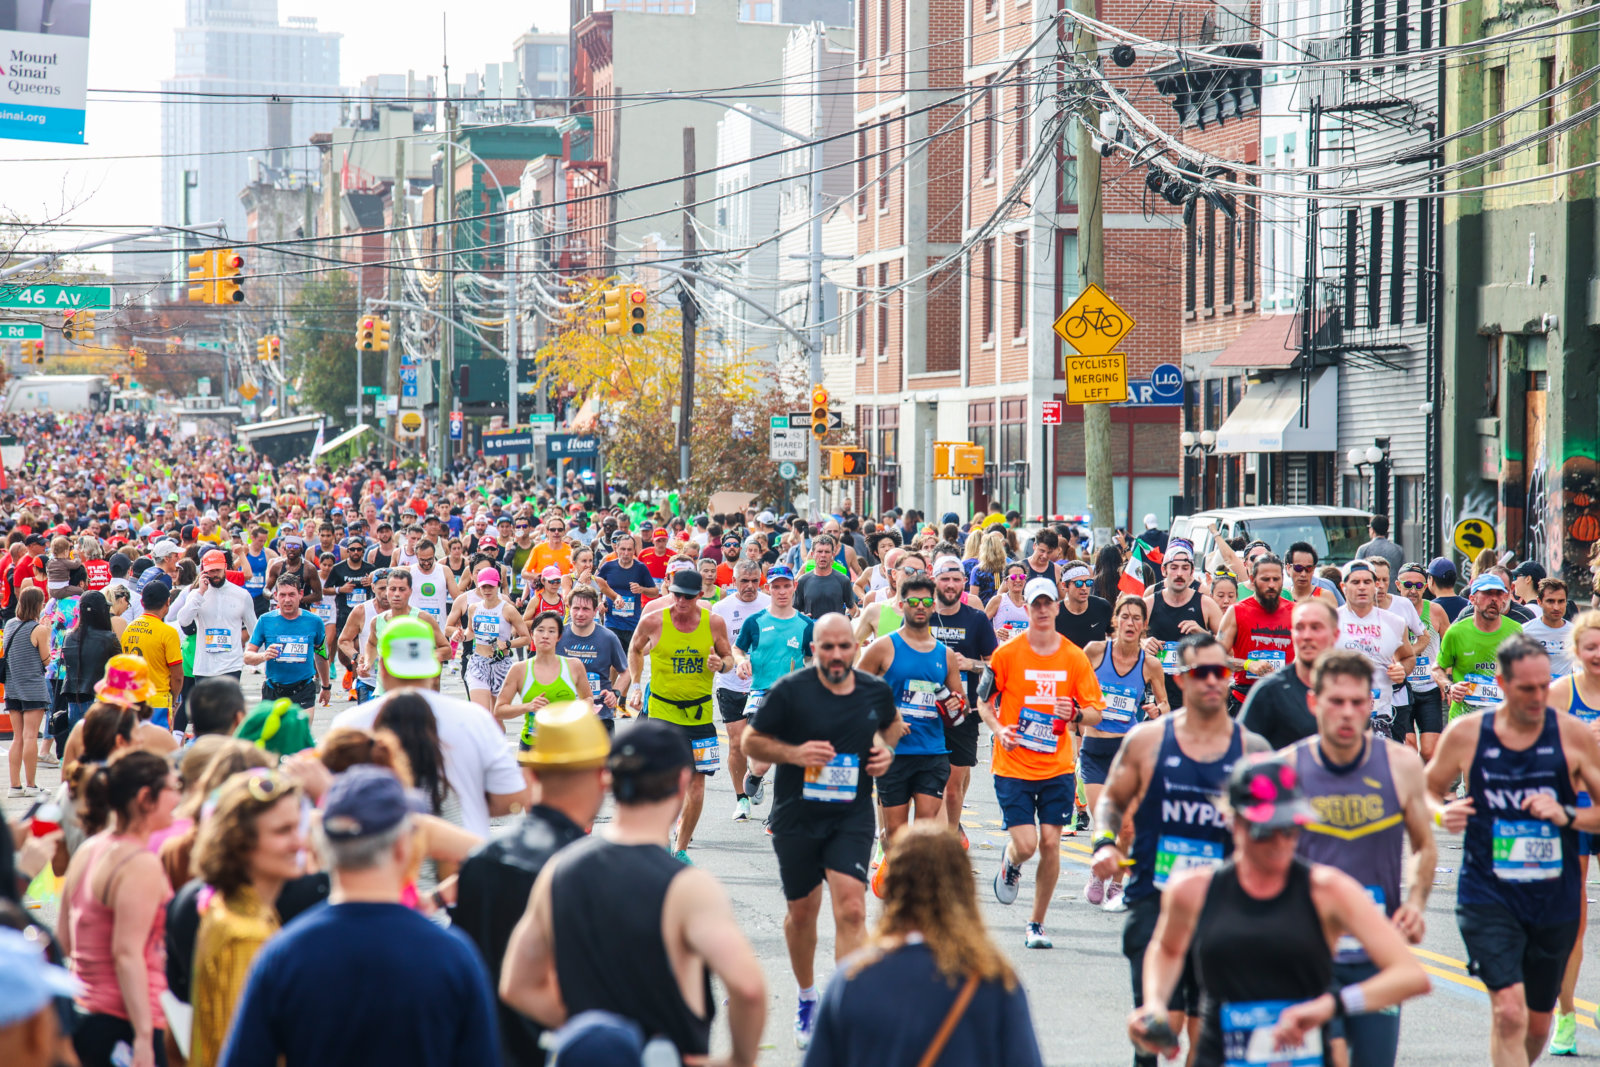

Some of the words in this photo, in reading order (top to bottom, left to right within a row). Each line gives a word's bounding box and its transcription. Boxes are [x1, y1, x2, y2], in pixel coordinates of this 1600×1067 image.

[10, 50, 57, 65] Mount
[9, 65, 47, 79] Sinai
[8, 80, 61, 95] Queens
[18, 289, 46, 304] 46
[56, 290, 81, 305] Av
[8, 326, 25, 336] Rd
[1071, 359, 1120, 370] CYCLISTS
[1073, 373, 1119, 385] MERGING
[1084, 388, 1110, 398] LEFT
[567, 438, 594, 449] flow
[773, 441, 803, 449] SHARED
[128, 627, 152, 635] CHINCHA
[1347, 623, 1381, 637] JAMES
[670, 657, 704, 666] TEAM
[676, 665, 703, 674] KIDS
[1035, 681, 1057, 697] 321
[1112, 696, 1127, 709] 9115
